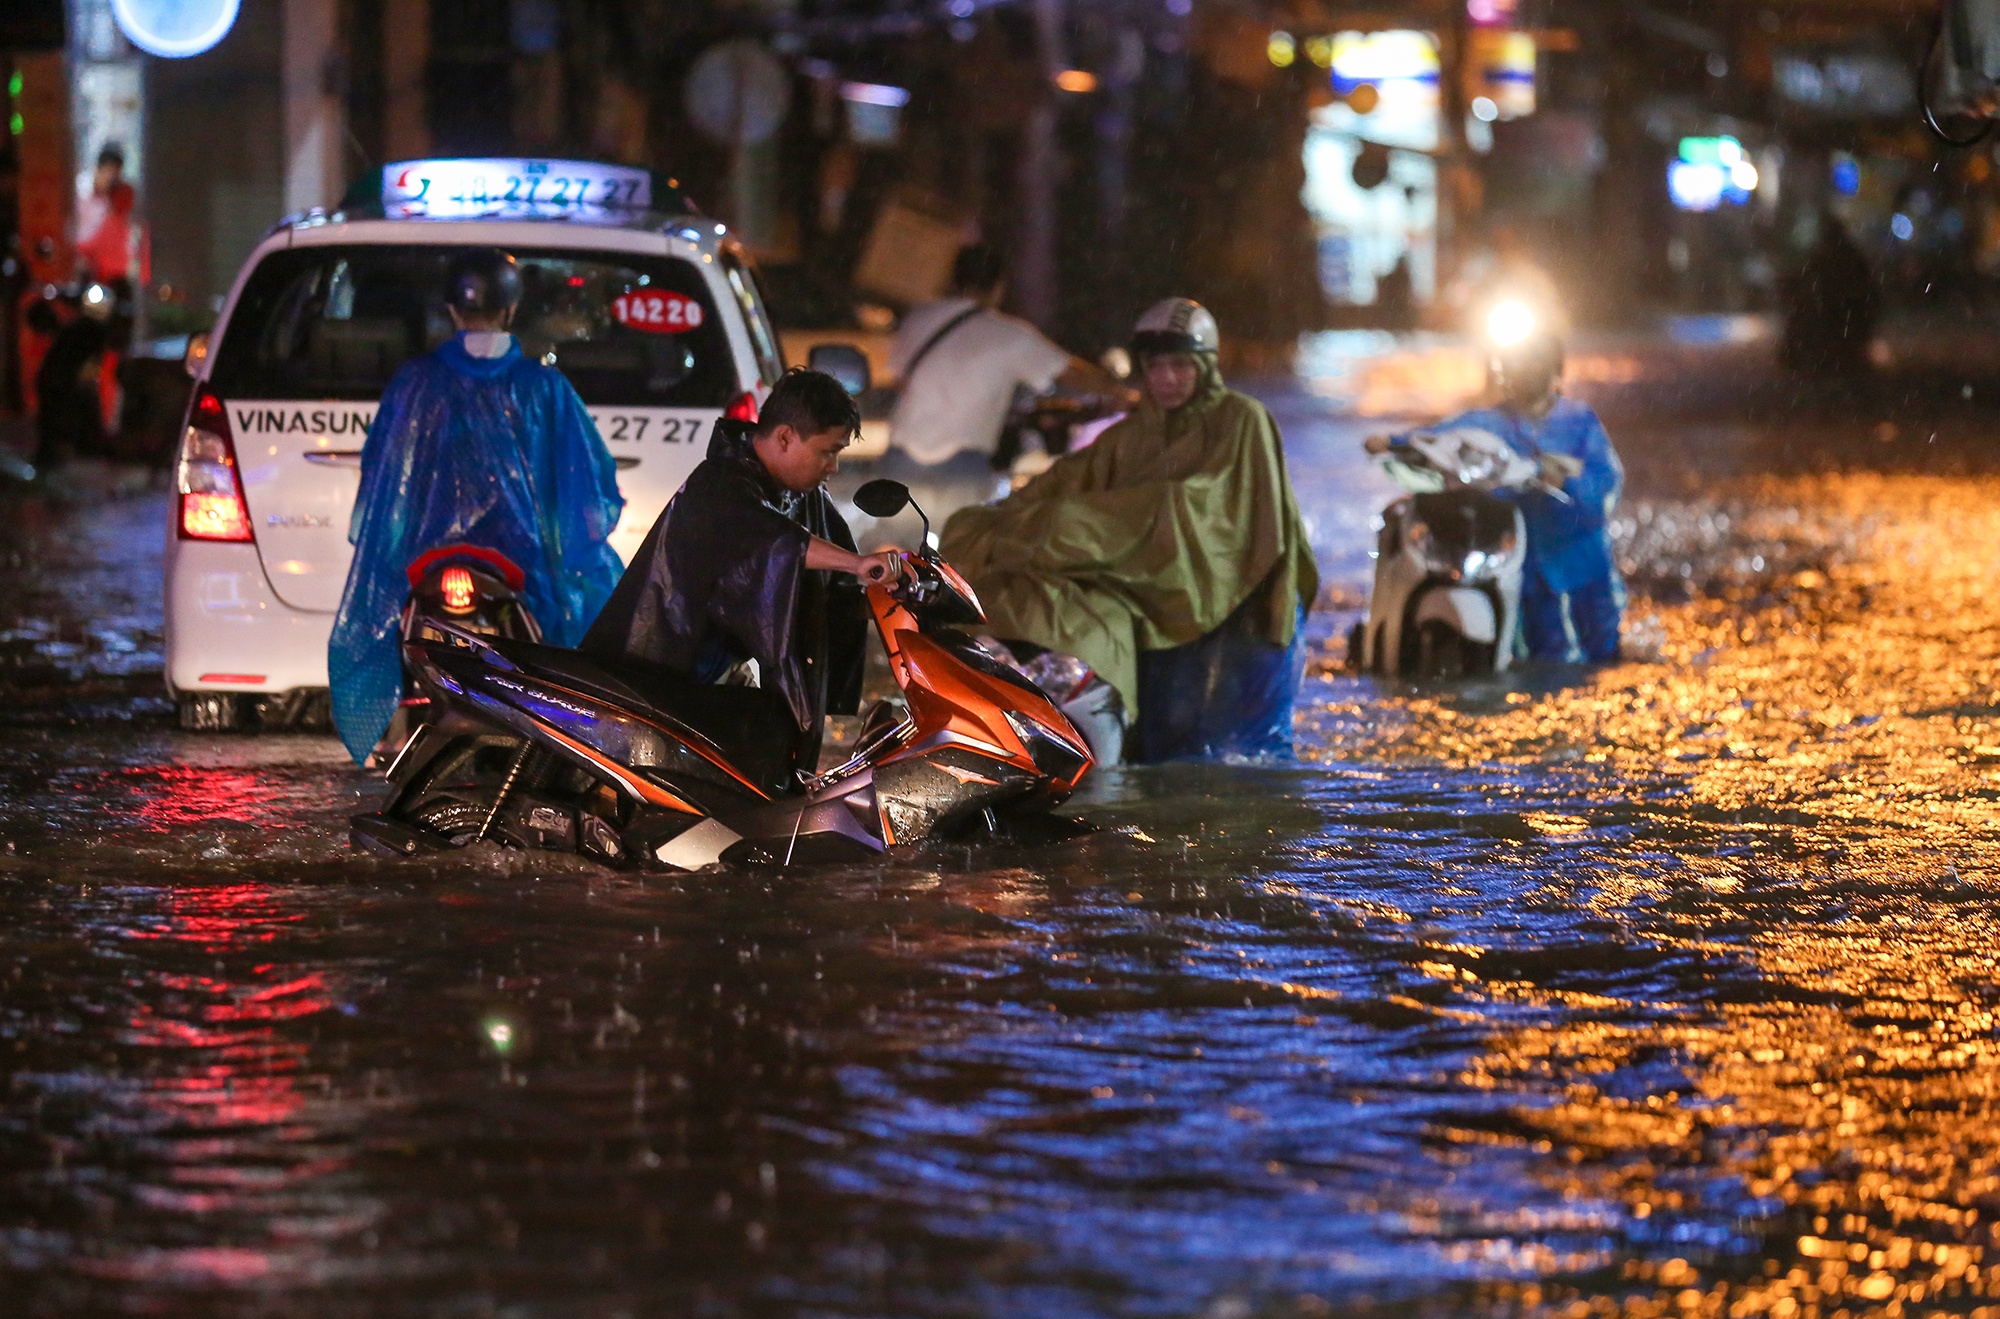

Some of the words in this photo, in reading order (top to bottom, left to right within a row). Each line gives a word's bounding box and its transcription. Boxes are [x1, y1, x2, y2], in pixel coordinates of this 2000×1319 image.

[550, 177, 591, 205] 27
[602, 178, 641, 205] 27
[615, 297, 702, 327] 14220
[237, 408, 371, 434] VINASUN
[610, 416, 650, 441] 27
[662, 418, 702, 444] 27
